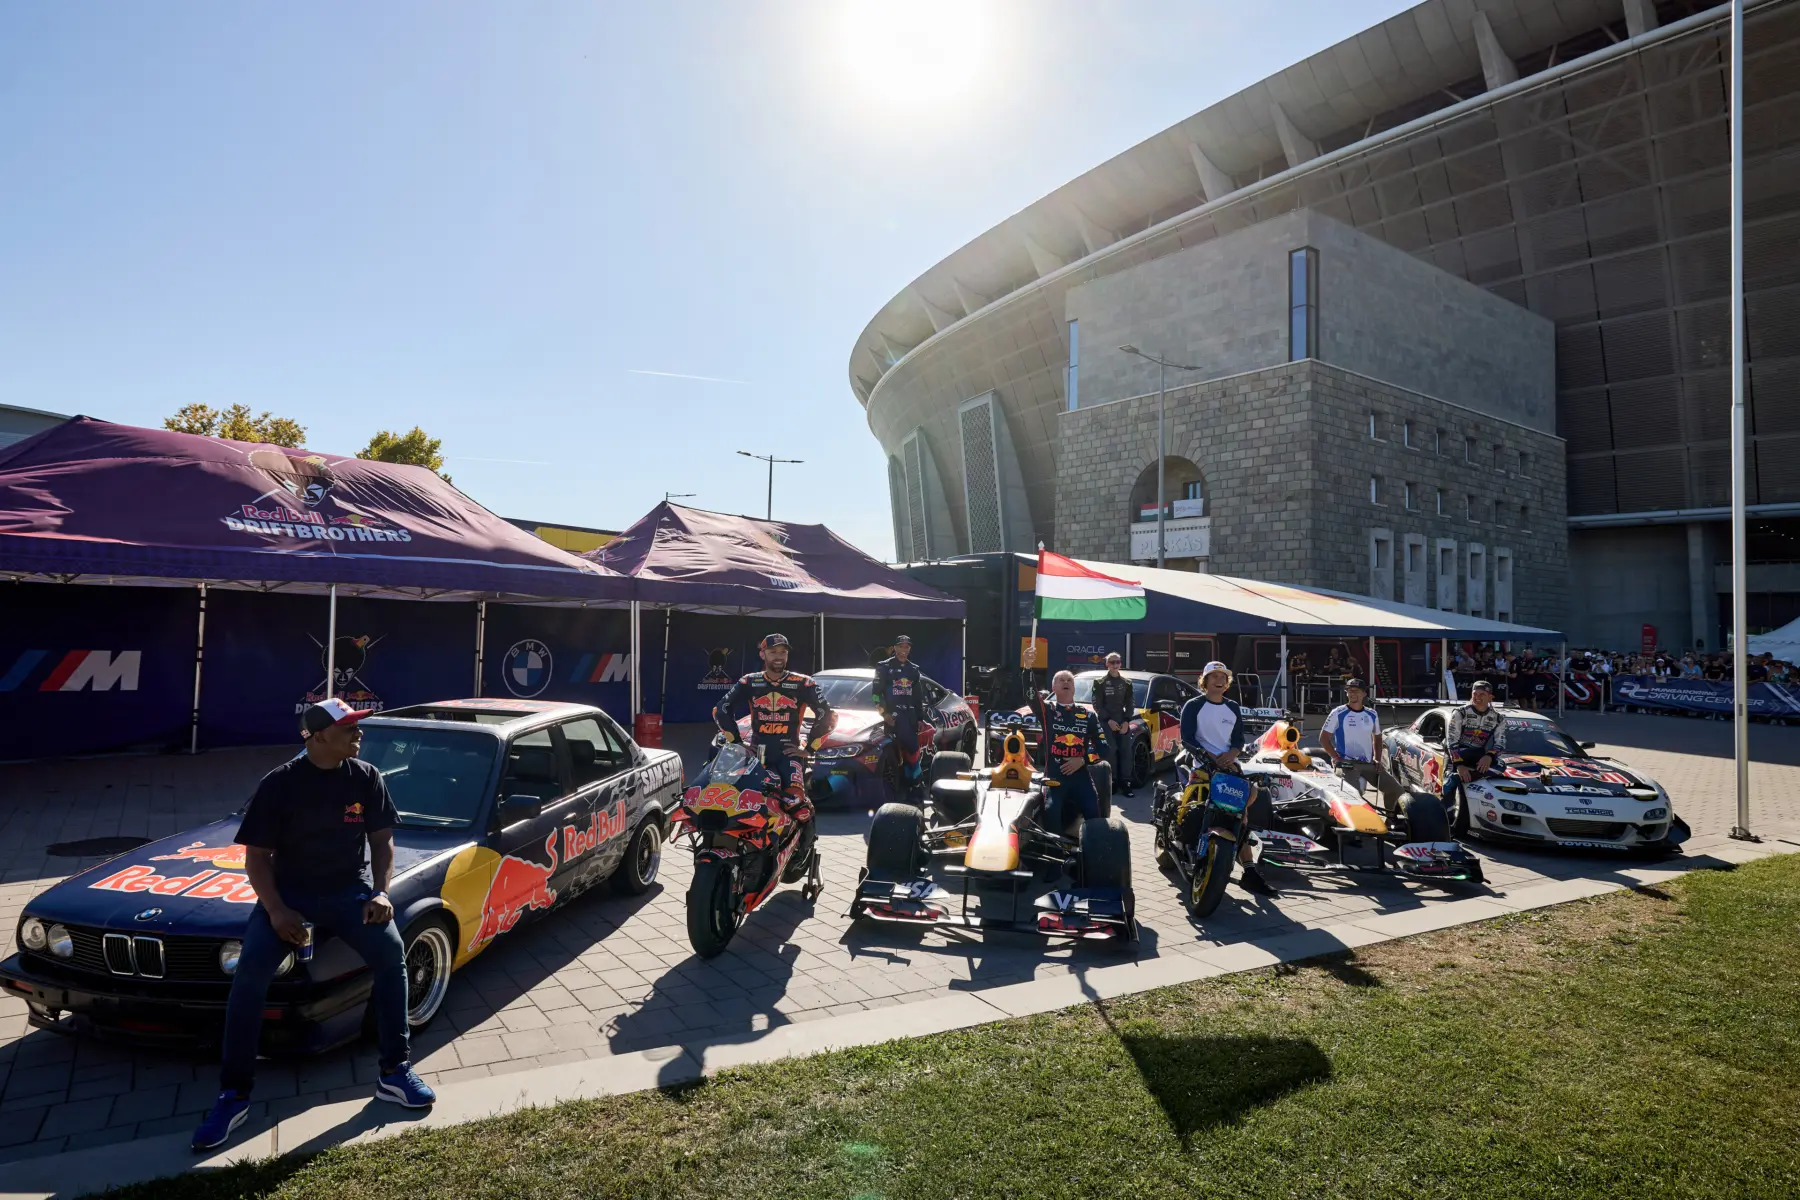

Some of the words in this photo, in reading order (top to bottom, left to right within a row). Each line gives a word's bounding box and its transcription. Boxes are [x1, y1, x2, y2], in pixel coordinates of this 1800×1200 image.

[242, 504, 284, 522] Red
[285, 507, 326, 524] Bull
[225, 516, 412, 542] DRIFTBROTHERS
[511, 642, 548, 658] BMW
[1066, 645, 1106, 654] ORACLE
[1704, 696, 1765, 707] CENER
[757, 712, 773, 721] Red
[773, 712, 790, 721] Bull
[759, 723, 789, 734] KTM
[1052, 724, 1087, 734] ORACLE
[1051, 745, 1069, 756] Red
[641, 765, 664, 796] SAM
[699, 787, 735, 809] 94
[563, 812, 597, 863] Red
[596, 798, 627, 845] Bull
[1400, 847, 1436, 858] HUG
[88, 864, 198, 897] Red
[182, 868, 260, 904] Bu
